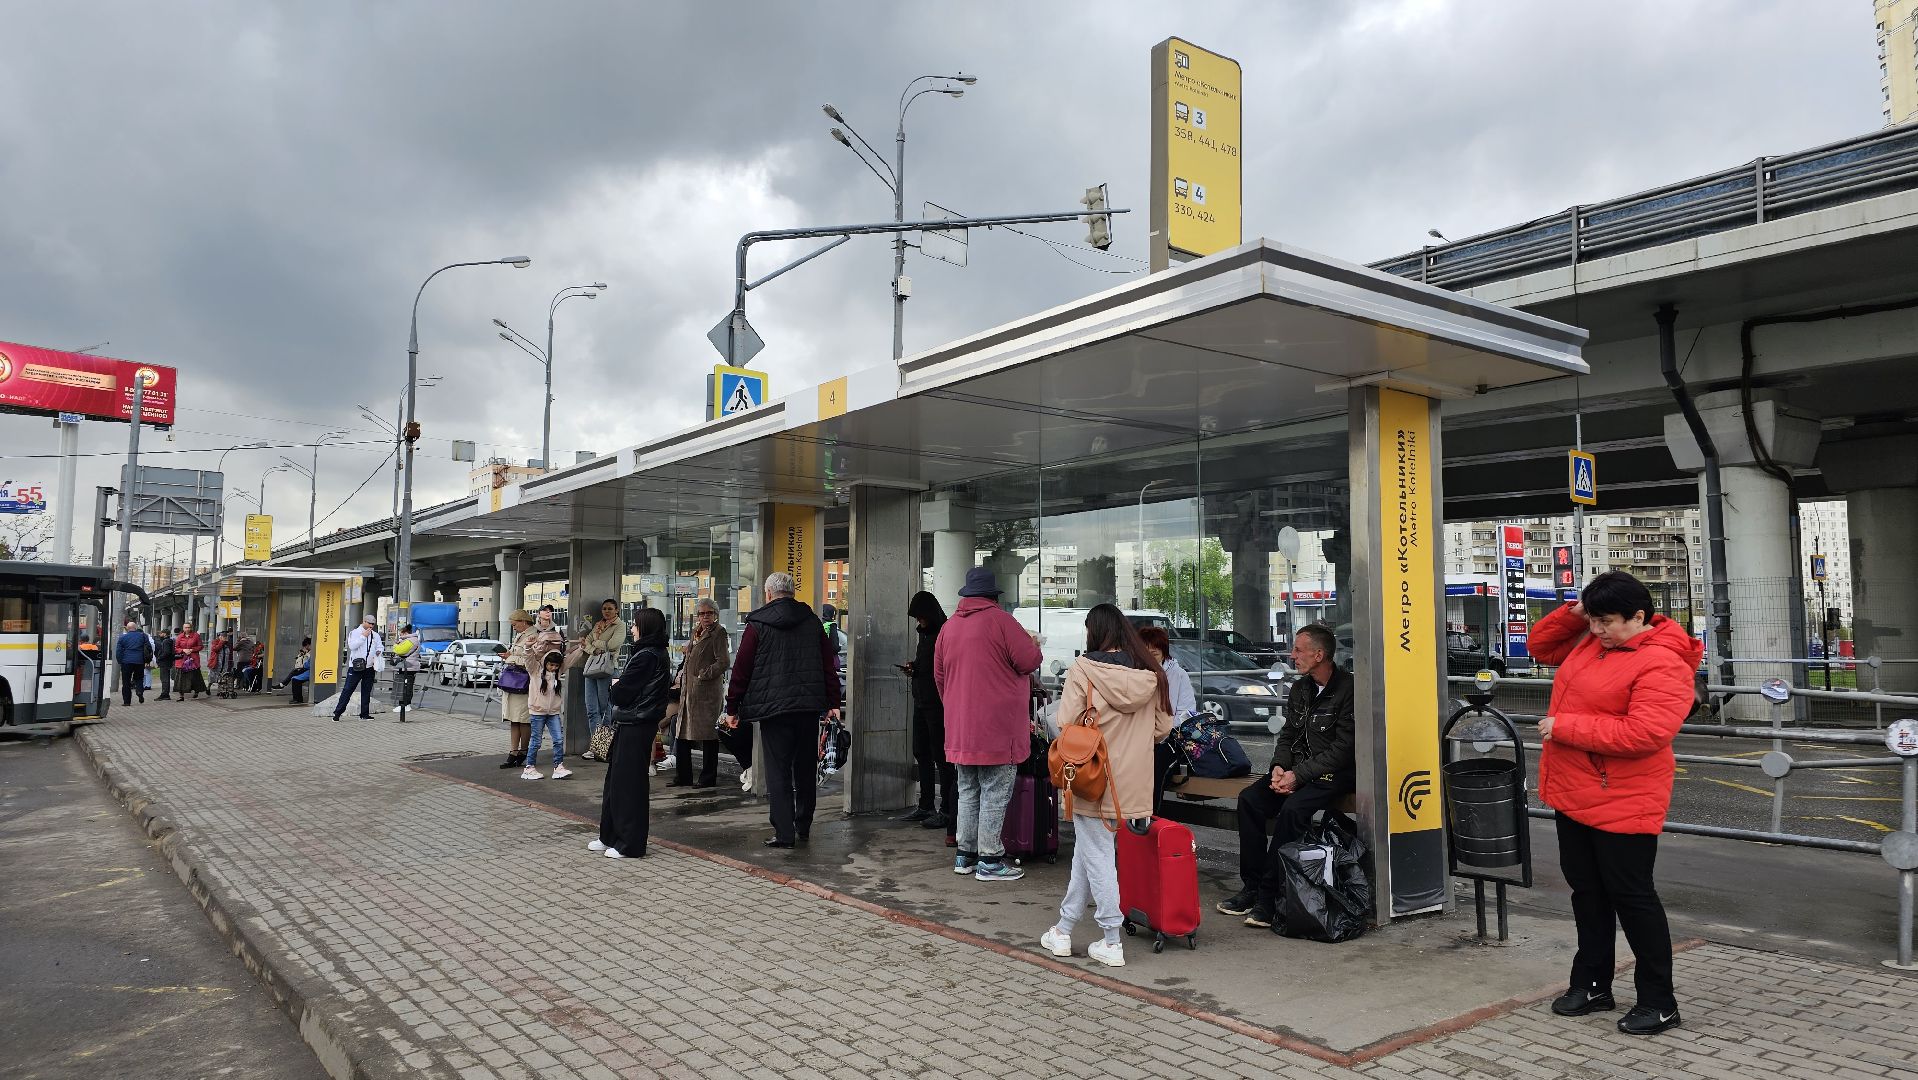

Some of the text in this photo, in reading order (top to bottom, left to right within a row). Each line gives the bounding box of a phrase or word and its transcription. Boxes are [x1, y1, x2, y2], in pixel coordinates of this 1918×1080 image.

[1195, 111, 1204, 125] 3
[1174, 126, 1237, 157] 358, 441, 478
[1195, 186, 1204, 201] 4
[1174, 202, 1215, 223] 330, 424
[829, 390, 836, 405] 4
[1406, 429, 1418, 548] Metro Kotelniki
[1396, 429, 1411, 652] Метро «Котельники»
[794, 526, 803, 592] Metro Kotelniki
